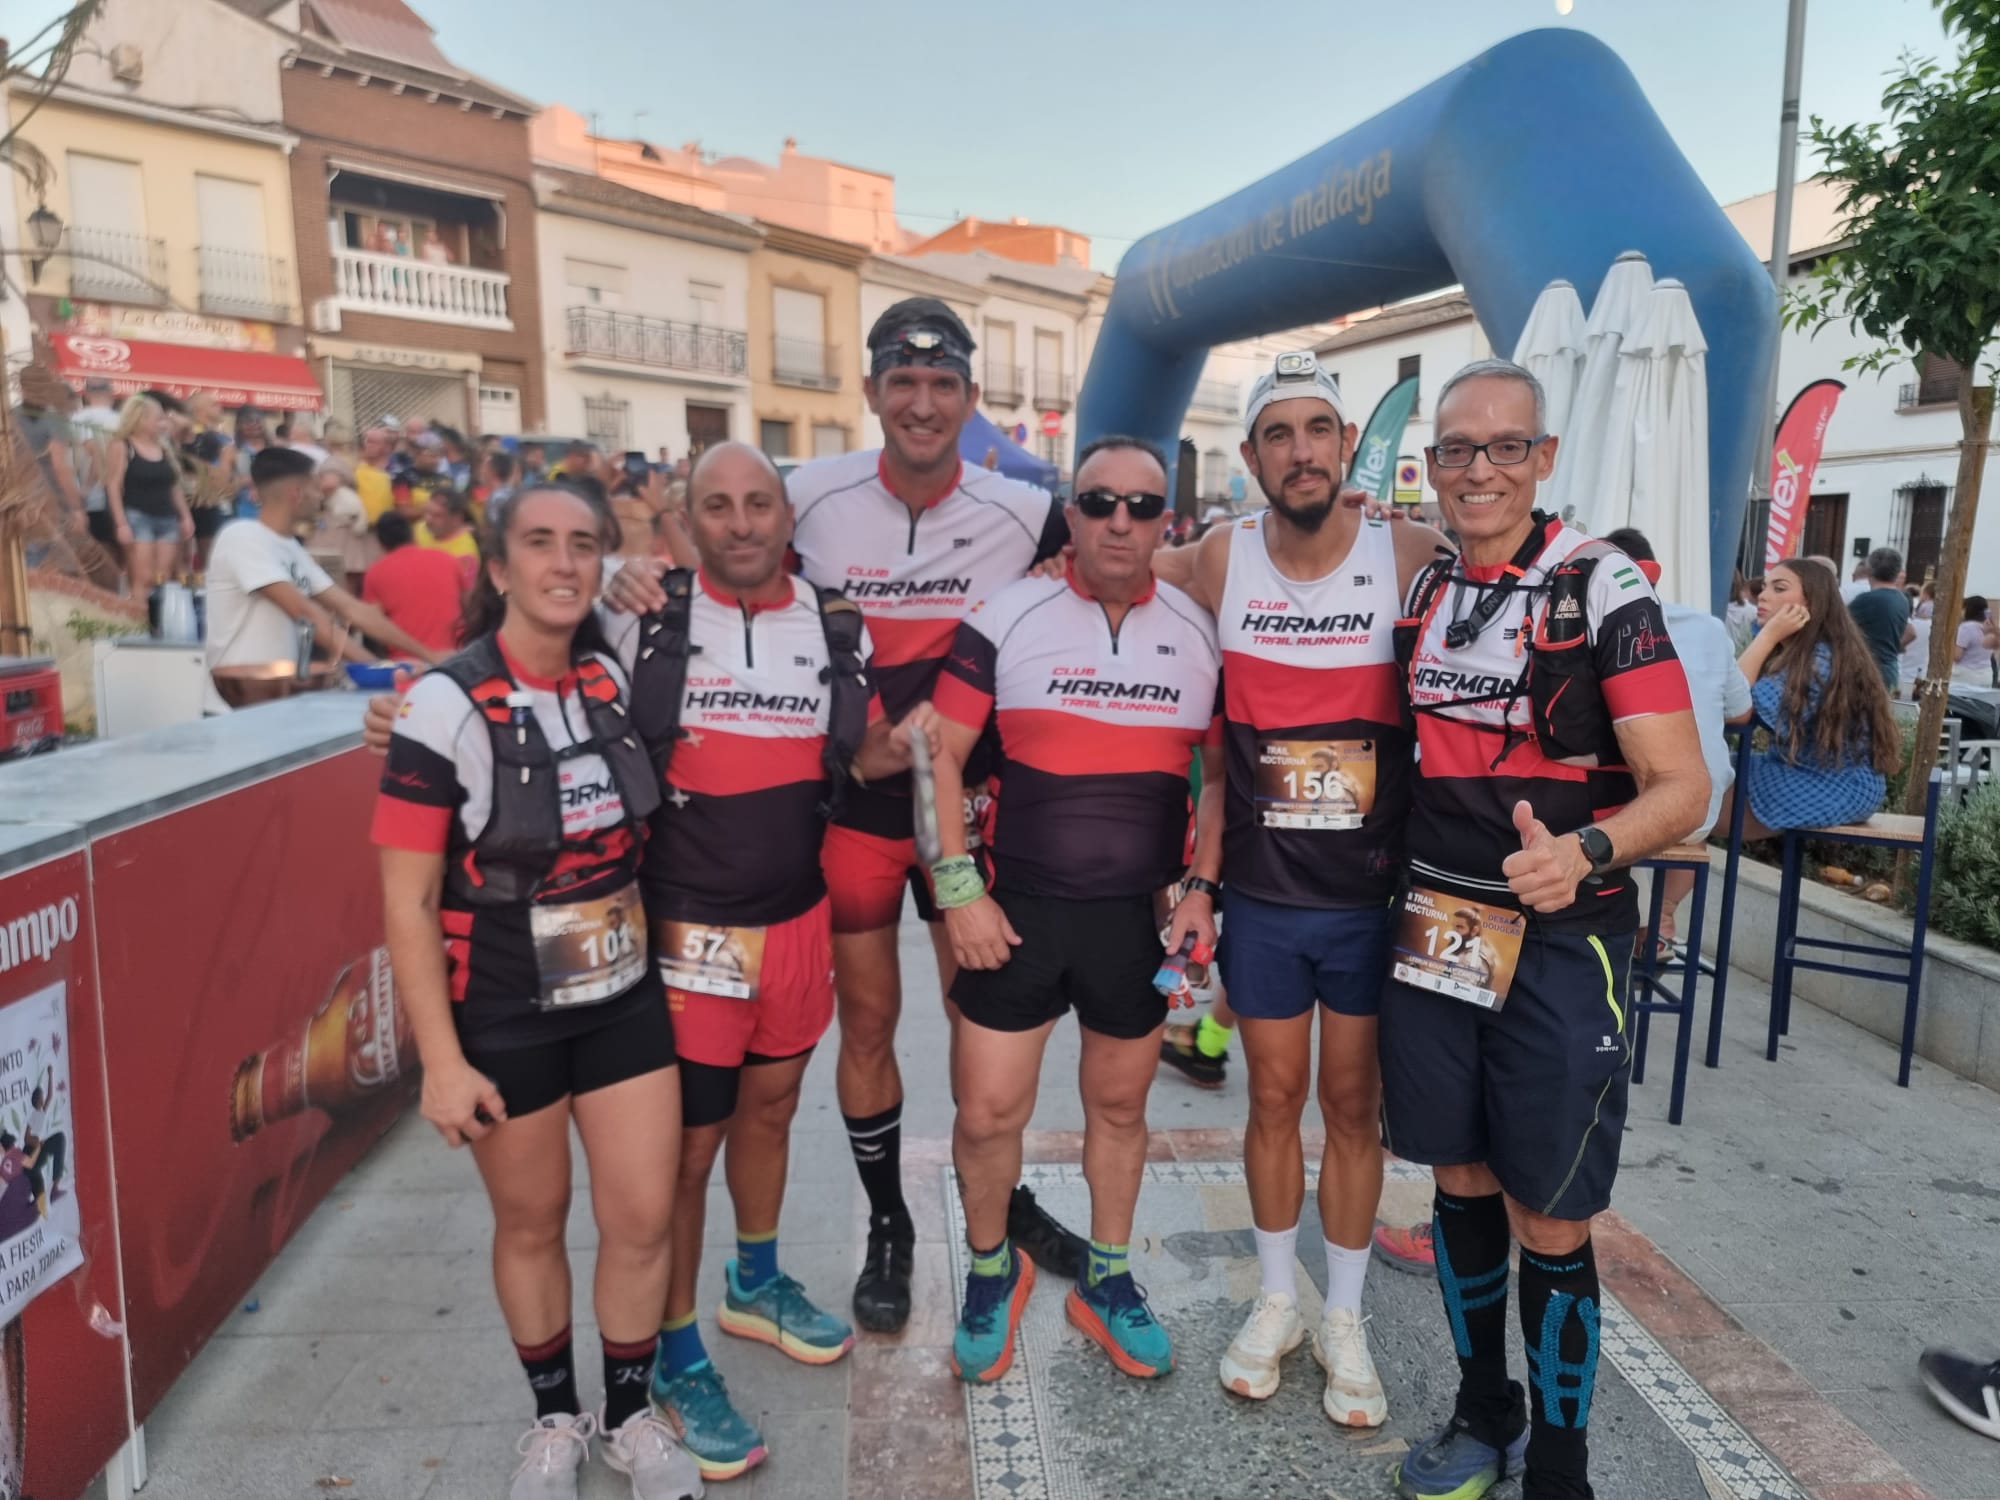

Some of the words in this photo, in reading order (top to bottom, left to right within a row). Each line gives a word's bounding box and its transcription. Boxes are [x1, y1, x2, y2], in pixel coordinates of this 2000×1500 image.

[847, 566, 889, 577] CLUB
[843, 578, 972, 597] HARMAN
[1248, 600, 1289, 611] CLUB
[1241, 612, 1375, 632] HARMAN
[1253, 635, 1293, 645] TRAIL
[1296, 634, 1370, 646] RUNNING
[1052, 667, 1096, 676] CLUB
[687, 678, 733, 688] CLUB
[1047, 679, 1181, 704] HARMAN
[686, 692, 821, 713] HARMAN
[1061, 698, 1103, 709] TRAIL
[1107, 700, 1179, 715] RUNNING
[1452, 692, 1522, 712] RNNING
[701, 713, 744, 723] TRAIL
[748, 714, 817, 727] RUNNING
[1283, 770, 1345, 801] 156
[1414, 893, 1435, 908] TRAIL
[1405, 902, 1449, 922] NOCTURNA
[682, 928, 726, 962] 57
[1425, 925, 1482, 967] 121
[0, 1049, 23, 1075] NTO
[10, 1226, 45, 1267] FIESTA
[6, 1265, 36, 1301] PARA
